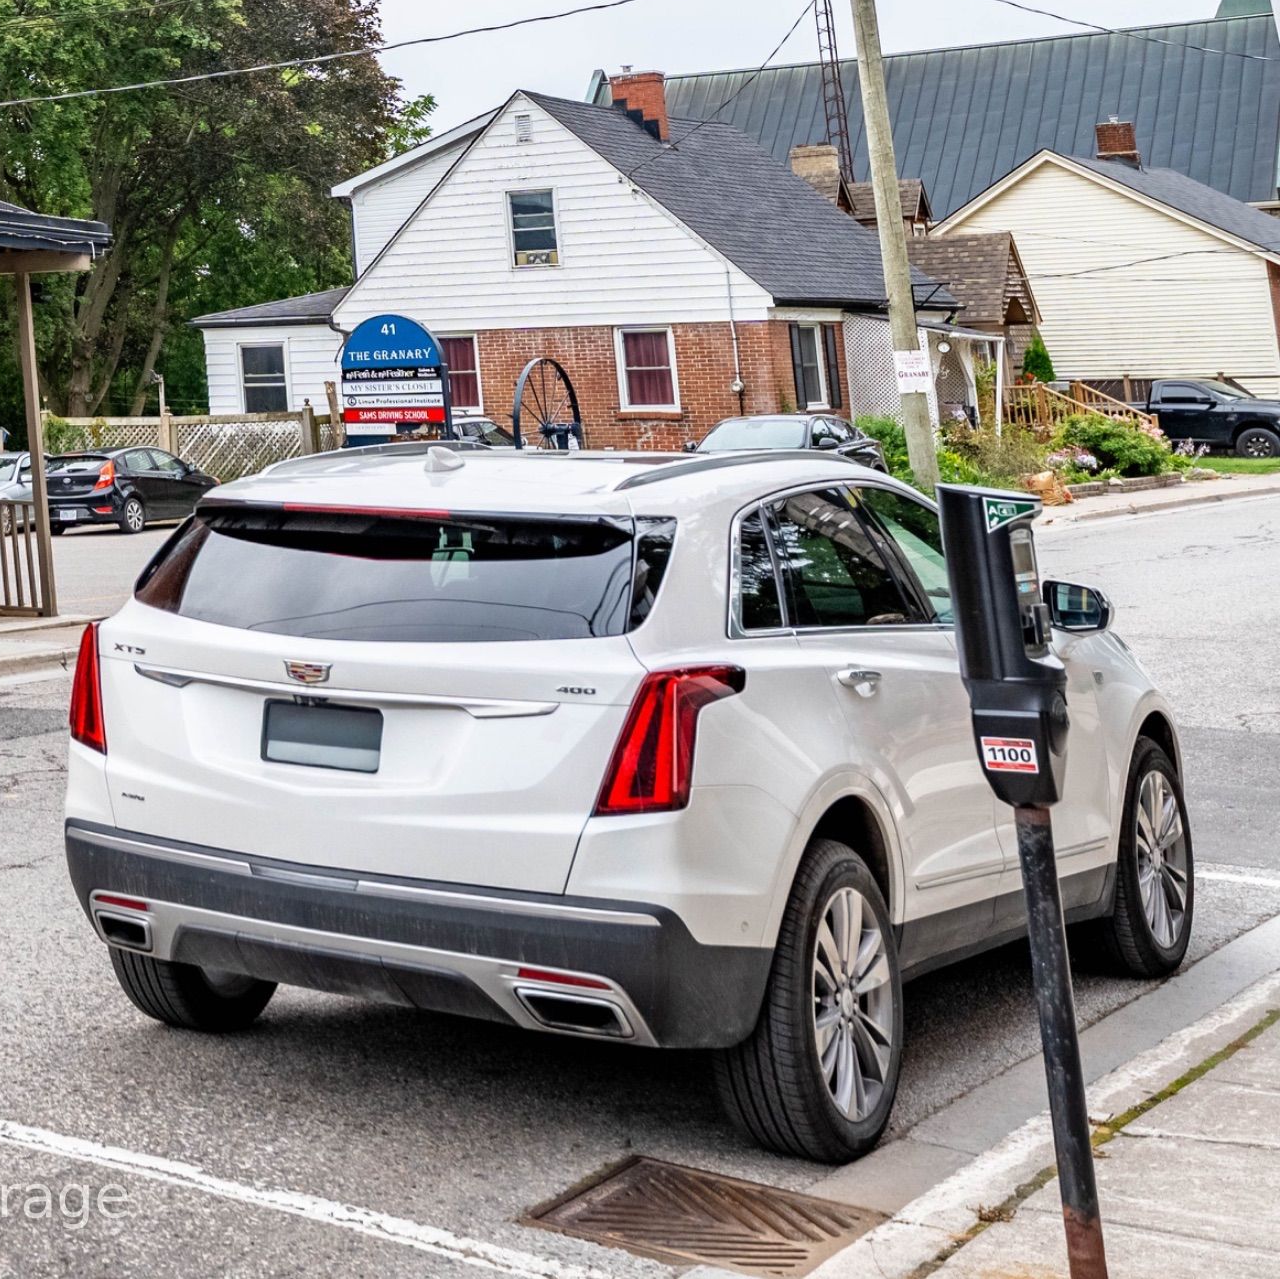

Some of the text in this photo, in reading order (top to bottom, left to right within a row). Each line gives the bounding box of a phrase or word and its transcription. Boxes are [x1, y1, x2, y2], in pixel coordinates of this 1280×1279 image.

[381, 324, 395, 335] 41
[349, 348, 431, 361] THE GRANARY
[350, 382, 433, 392] MY SISTER'S CLOSET
[359, 410, 429, 419] SAMS DRIVING SCHOOL
[556, 686, 596, 695] 400
[988, 747, 1031, 762] 1100
